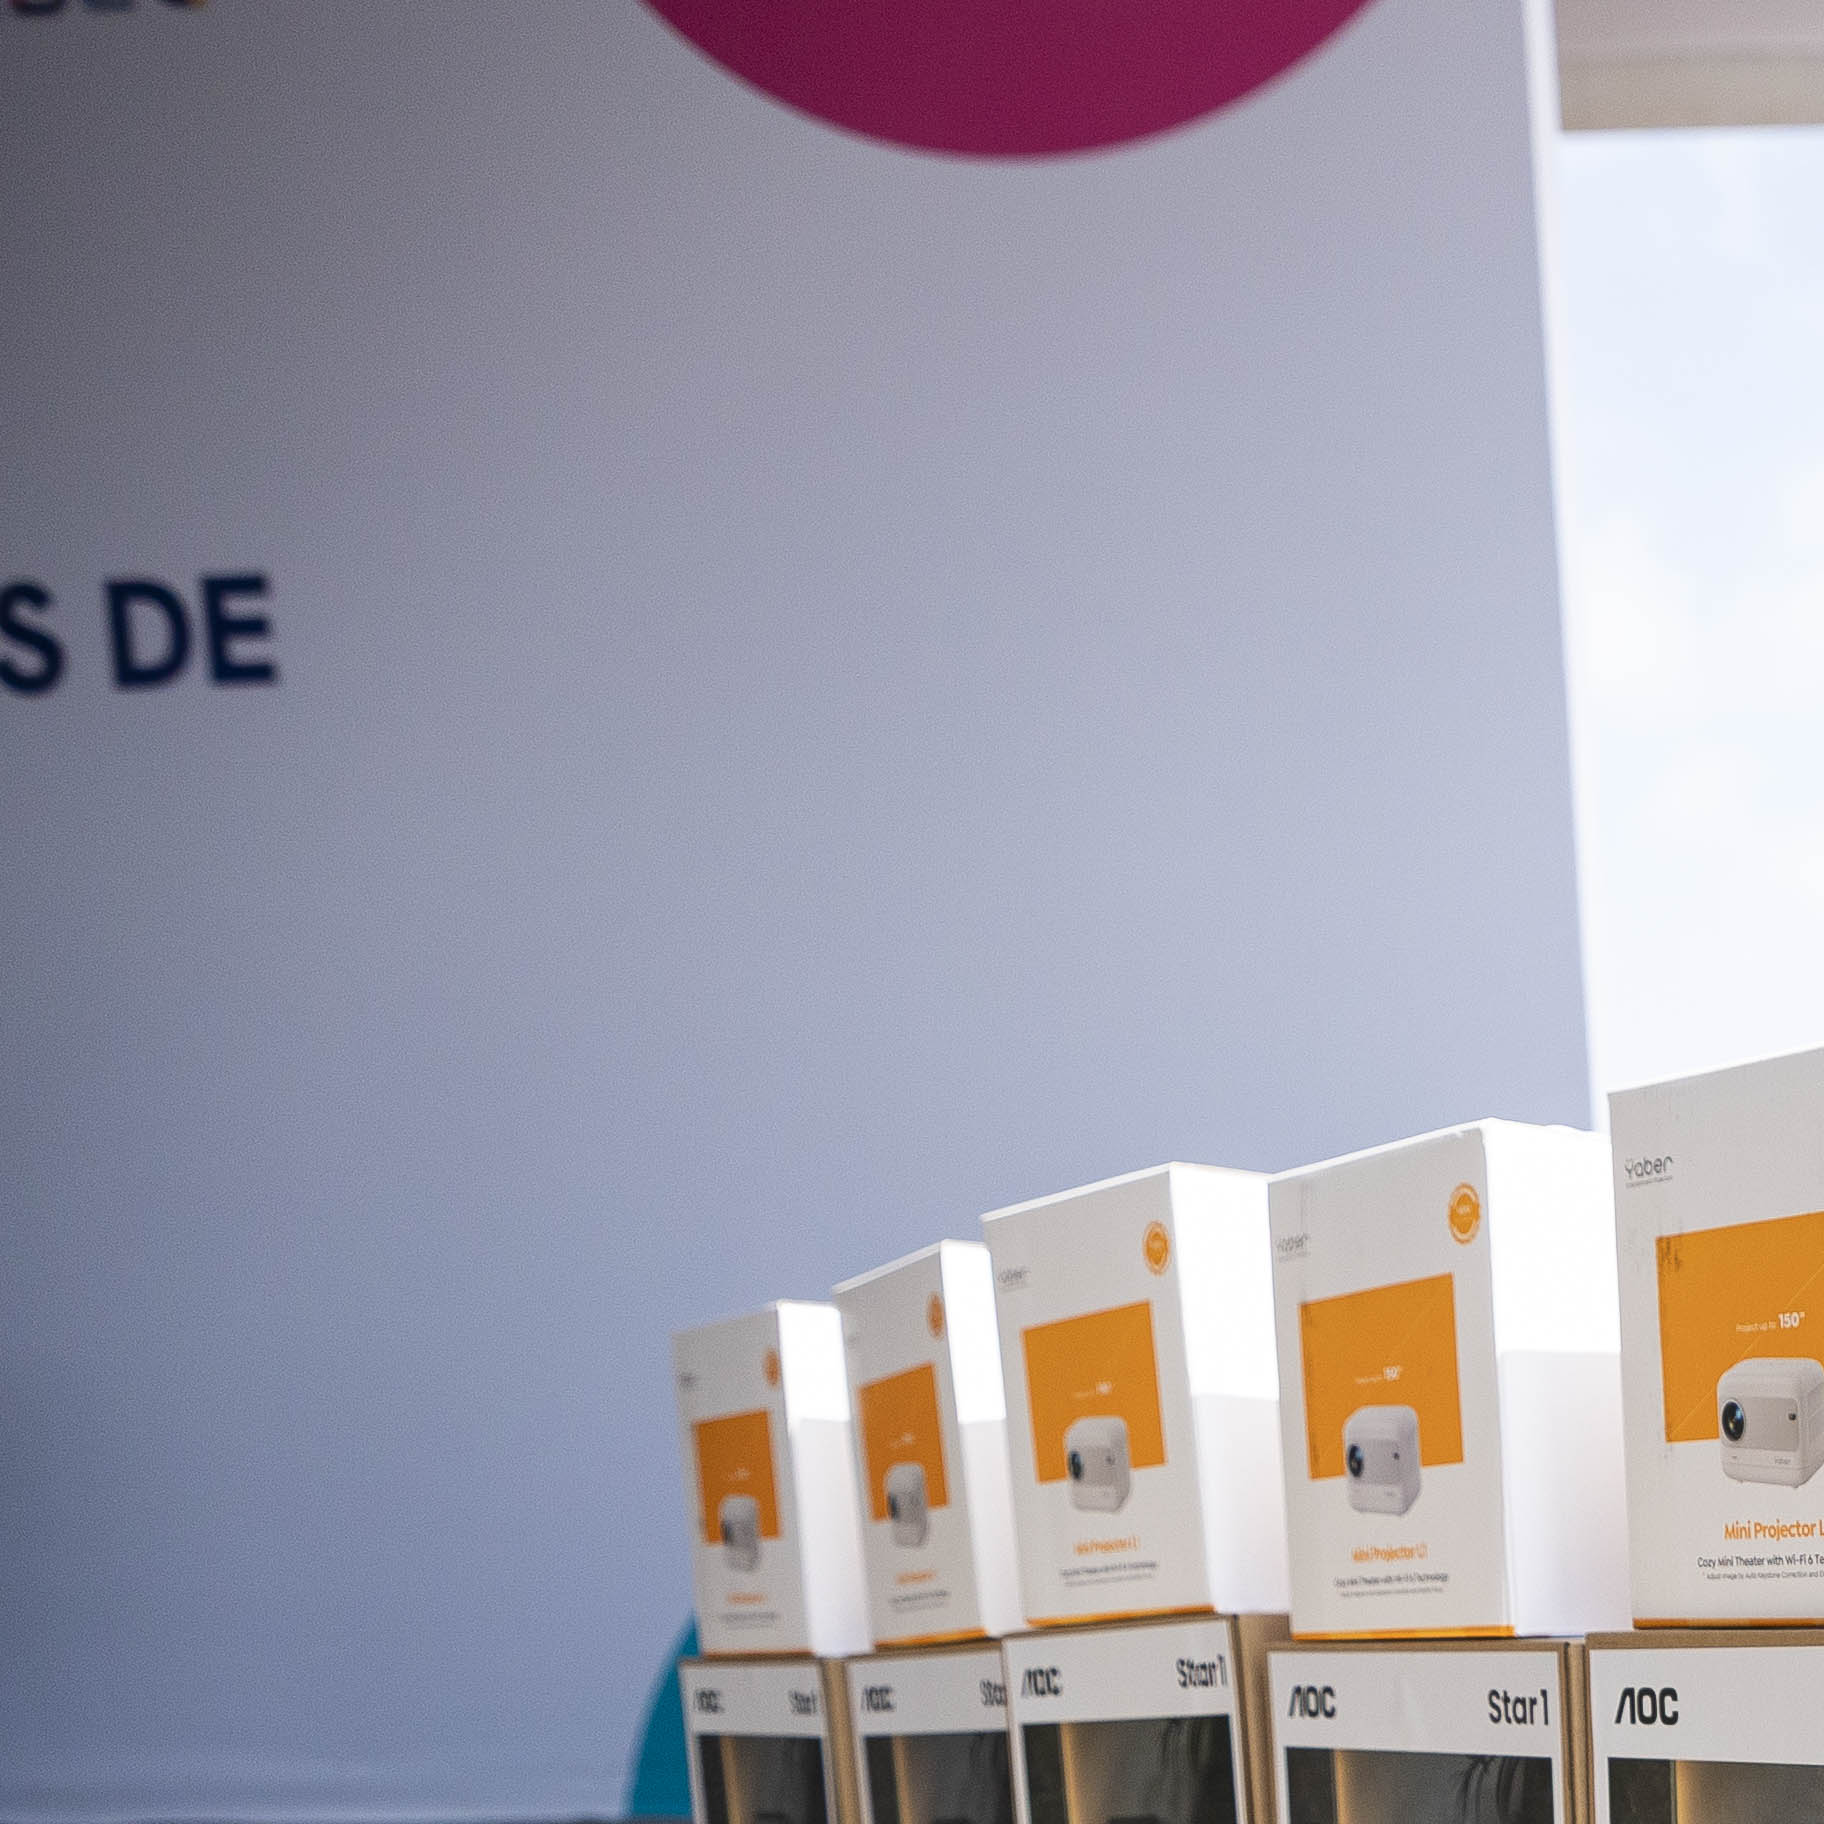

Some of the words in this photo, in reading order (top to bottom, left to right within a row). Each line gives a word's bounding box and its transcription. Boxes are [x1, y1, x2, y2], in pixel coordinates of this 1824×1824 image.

[103, 572, 279, 692] DE
[1725, 1520, 1751, 1540] Mini
[1754, 1519, 1816, 1541] Projector
[1698, 1556, 1716, 1568] Cozy
[1718, 1555, 1733, 1566] Mini
[1736, 1555, 1764, 1566] Theater
[1767, 1555, 1783, 1565] with
[1785, 1554, 1806, 1565] Wi-Fi
[1615, 1687, 1679, 1726] AOC
